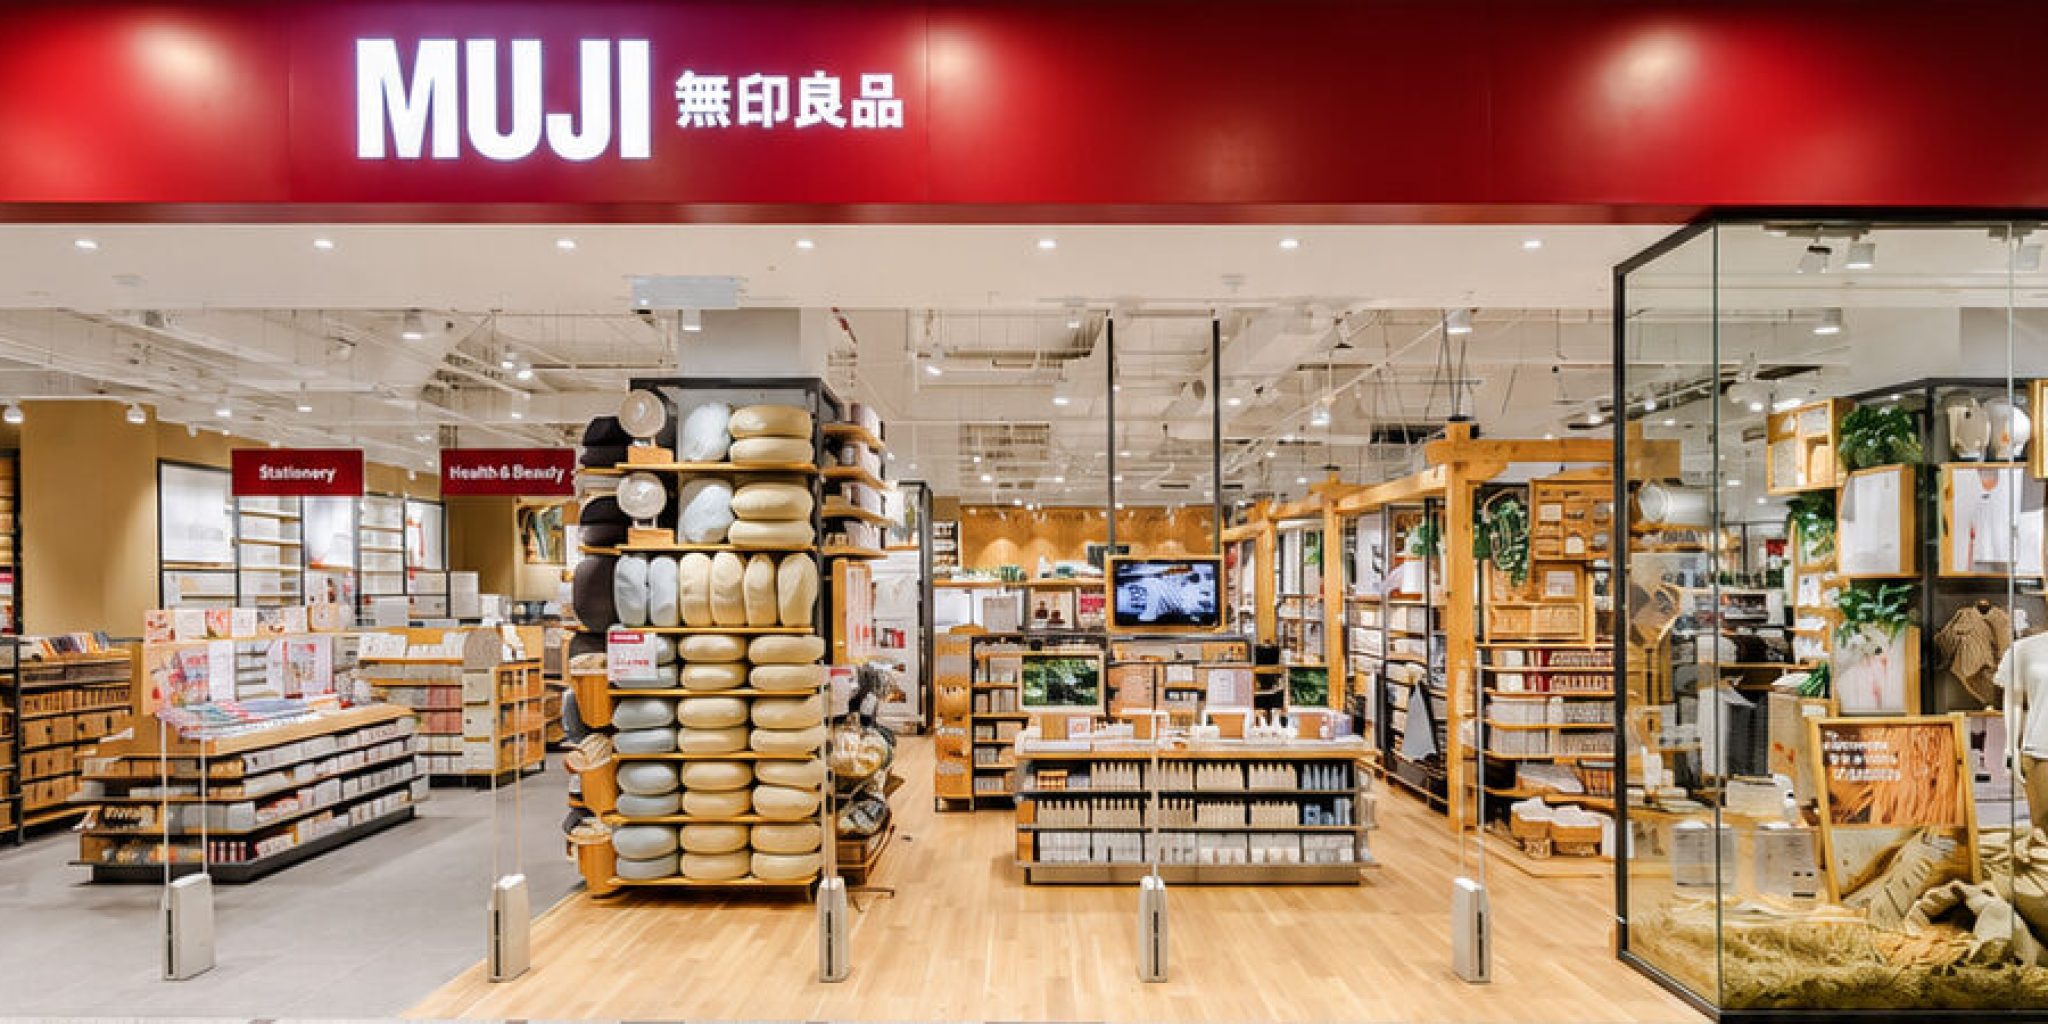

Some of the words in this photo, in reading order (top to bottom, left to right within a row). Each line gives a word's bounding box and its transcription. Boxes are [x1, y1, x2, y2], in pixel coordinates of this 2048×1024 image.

[356, 38, 651, 161] MUJI
[675, 71, 904, 129] 無印良品
[259, 464, 336, 483] Stationery
[450, 465, 498, 480] Health
[500, 464, 510, 480] &
[512, 464, 564, 484] Beauty
